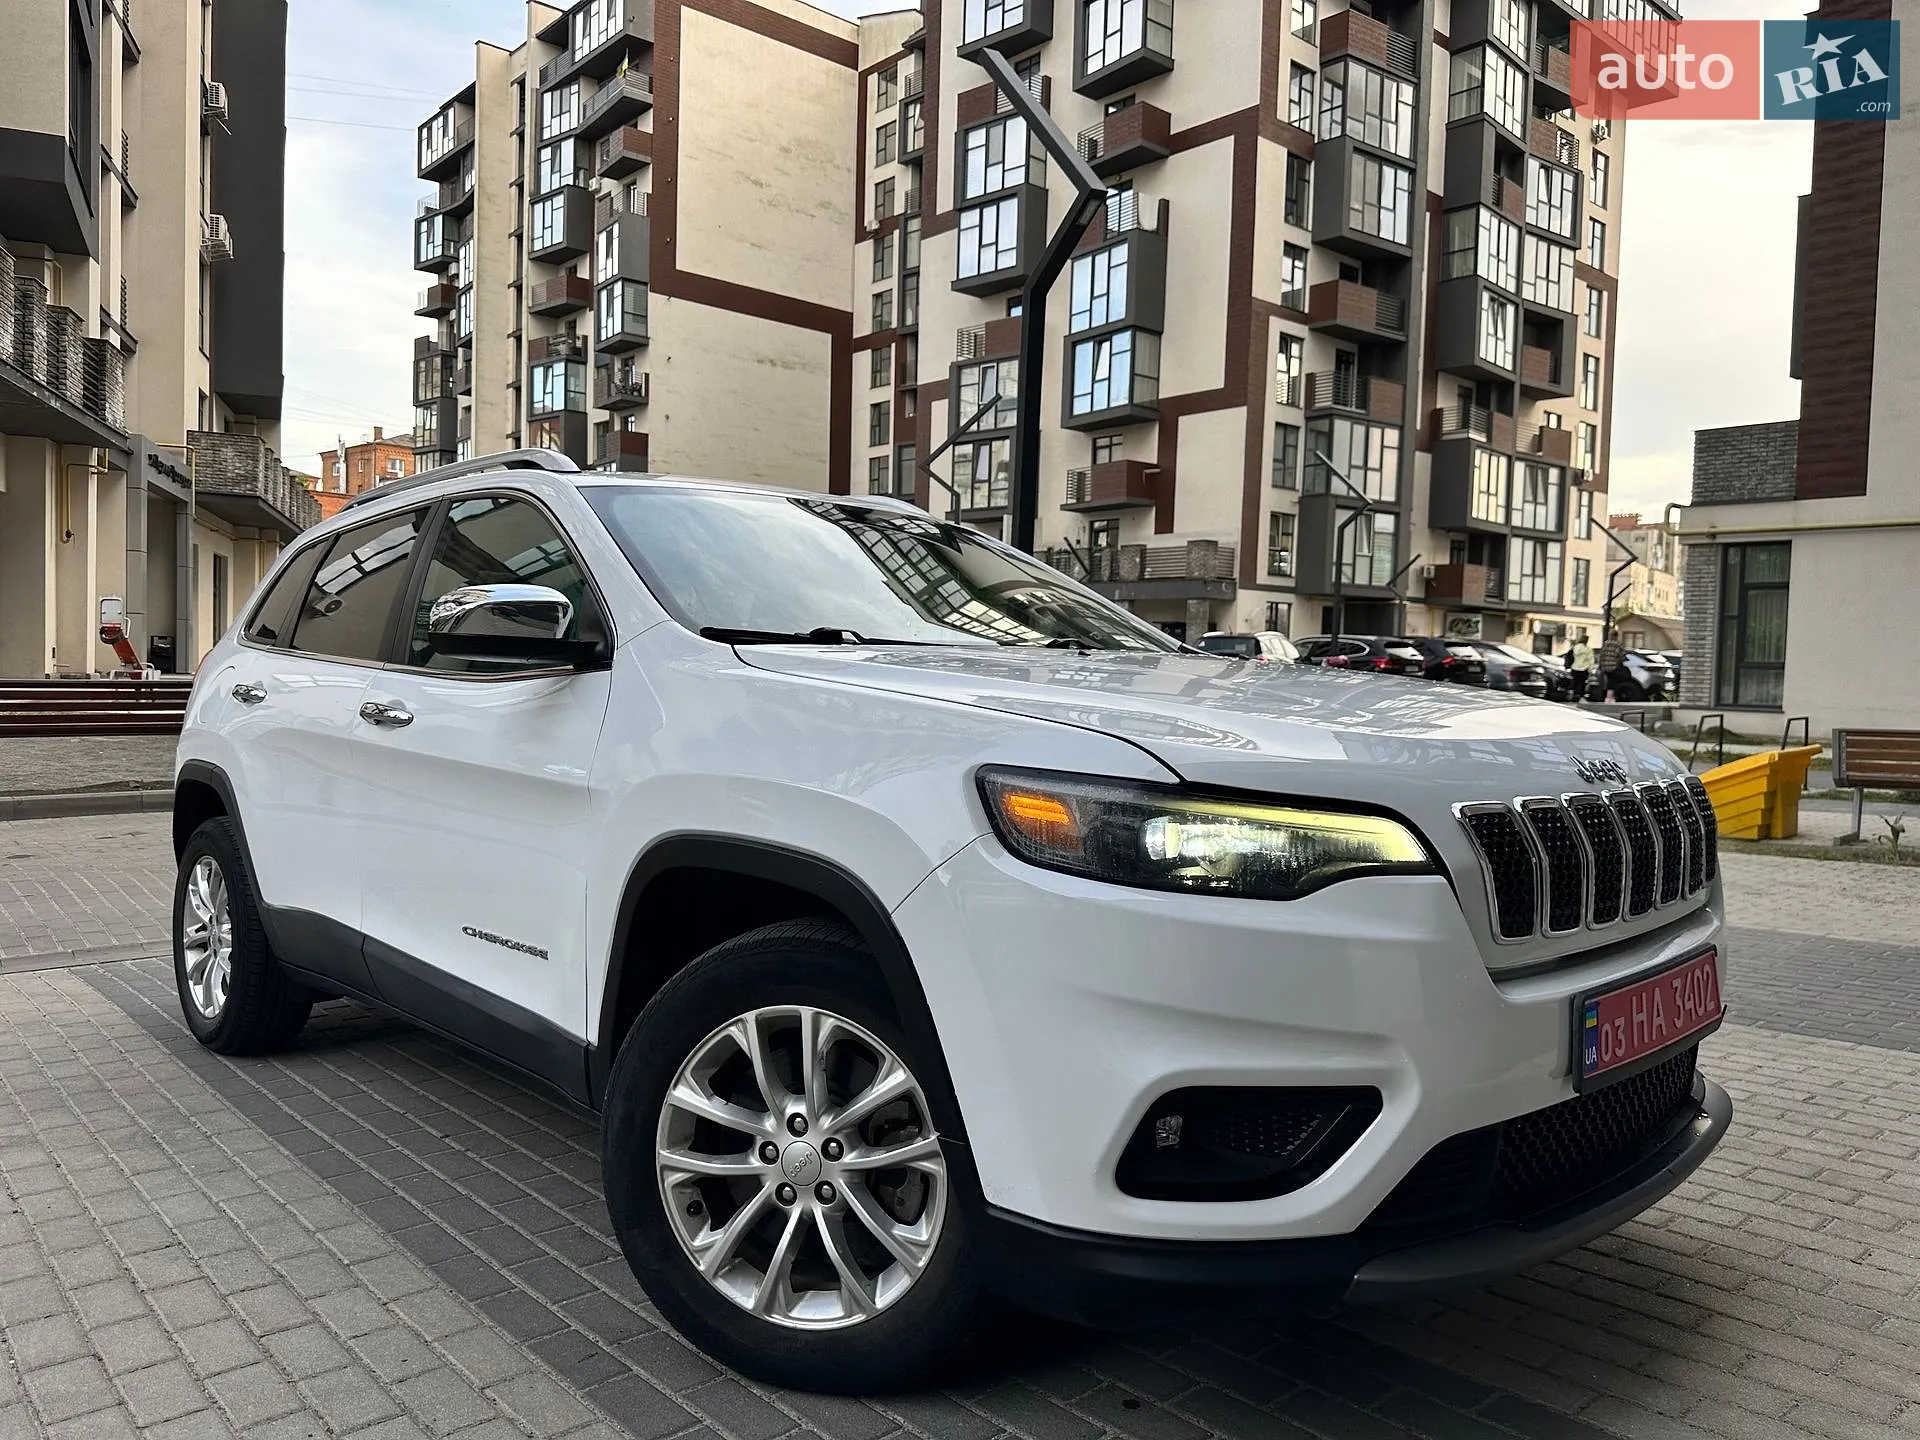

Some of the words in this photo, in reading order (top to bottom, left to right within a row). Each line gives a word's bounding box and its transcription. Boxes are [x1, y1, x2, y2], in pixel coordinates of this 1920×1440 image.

[1600, 1016, 1626, 1062] 03
[1631, 987, 1667, 1048] HA
[1671, 963, 1716, 1028] 3402
[1585, 1046, 1598, 1065] UA
